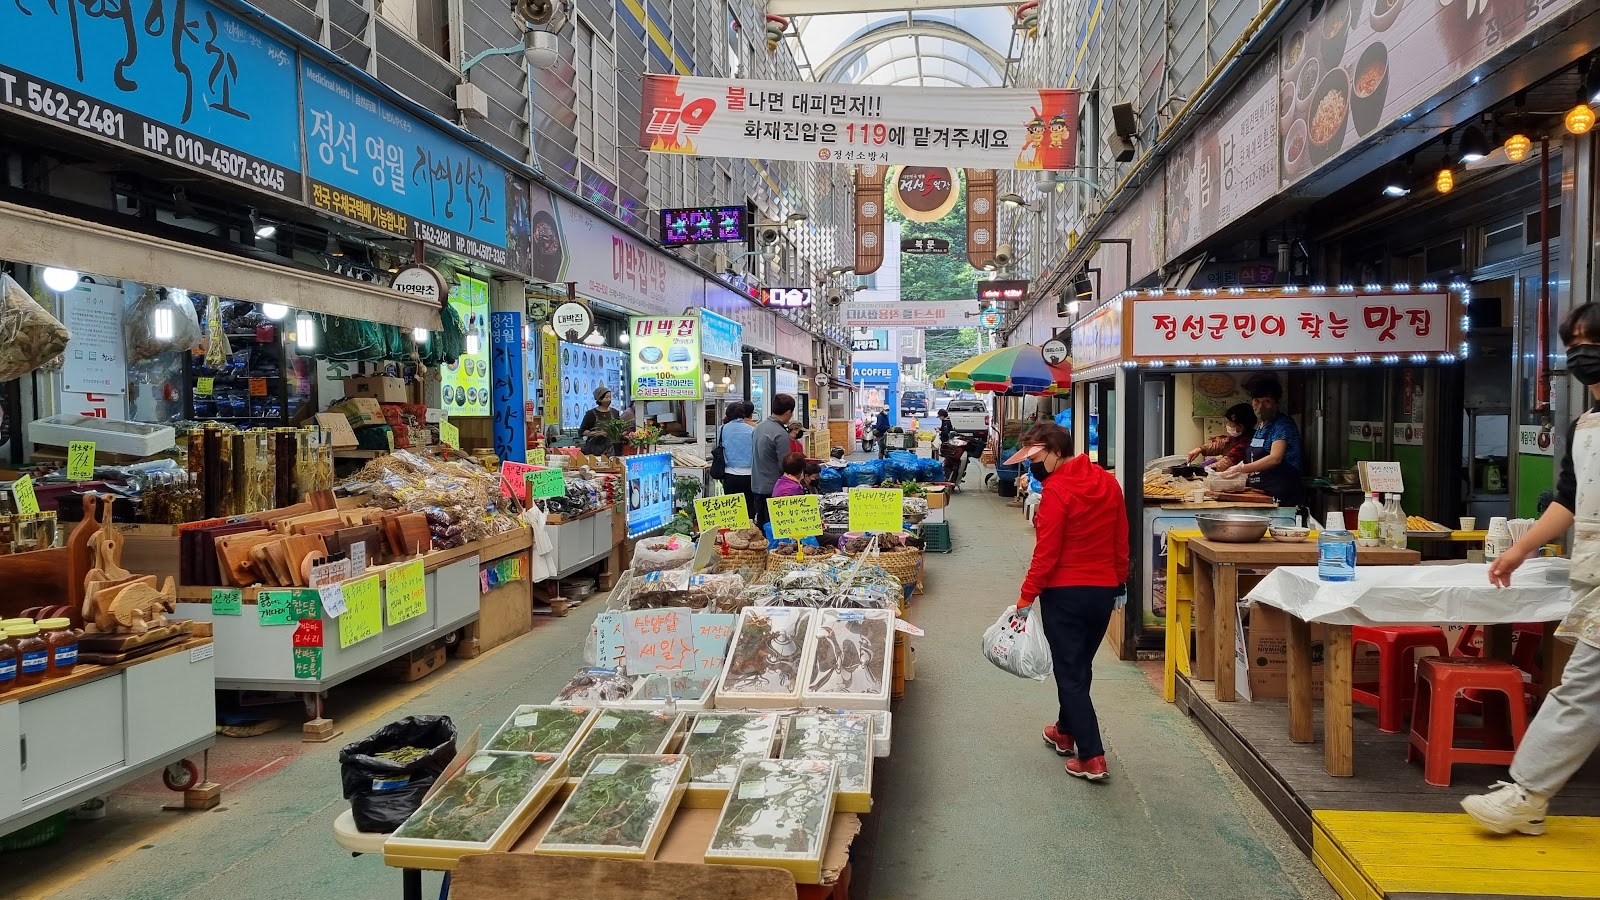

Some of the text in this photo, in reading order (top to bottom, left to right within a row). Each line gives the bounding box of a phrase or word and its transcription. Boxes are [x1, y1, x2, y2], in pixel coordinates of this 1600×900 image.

[306, 67, 351, 100] Medicinal Herb
[726, 86, 881, 117] 불나면 대피먼저!!
[28, 81, 125, 139] 562-2481
[143, 122, 172, 155] HP.
[175, 134, 285, 192] 010-4507-3345
[744, 120, 1009, 149] 화재진압은 119에 맡겨주세요
[310, 108, 358, 176] 정선
[365, 135, 406, 196] 영월
[834, 149, 889, 162] 정선소방서
[900, 172, 950, 196] 정선5일장
[313, 183, 408, 236] 전국 우체국택배 가능합니다
[422, 223, 451, 249] 562-2481
[455, 235, 466, 253] HP.
[466, 239, 506, 266] 010-4507-3345
[915, 240, 935, 249] 북문
[1207, 265, 1275, 286] 예림식당
[396, 284, 435, 296] 자연약초
[491, 314, 514, 328] 정선
[557, 313, 583, 324] 대박집
[635, 320, 696, 337] 대박집
[1152, 306, 1431, 341] 정선군민이 찾는 맛집
[491, 328, 515, 343] 영월
[861, 368, 892, 376] COFFEE
[702, 496, 742, 513] 말굽버섯
[772, 497, 811, 509] 영지버섯
[634, 611, 679, 634] 산양삼
[294, 635, 320, 643] 고사리
[640, 638, 675, 661] 세일
